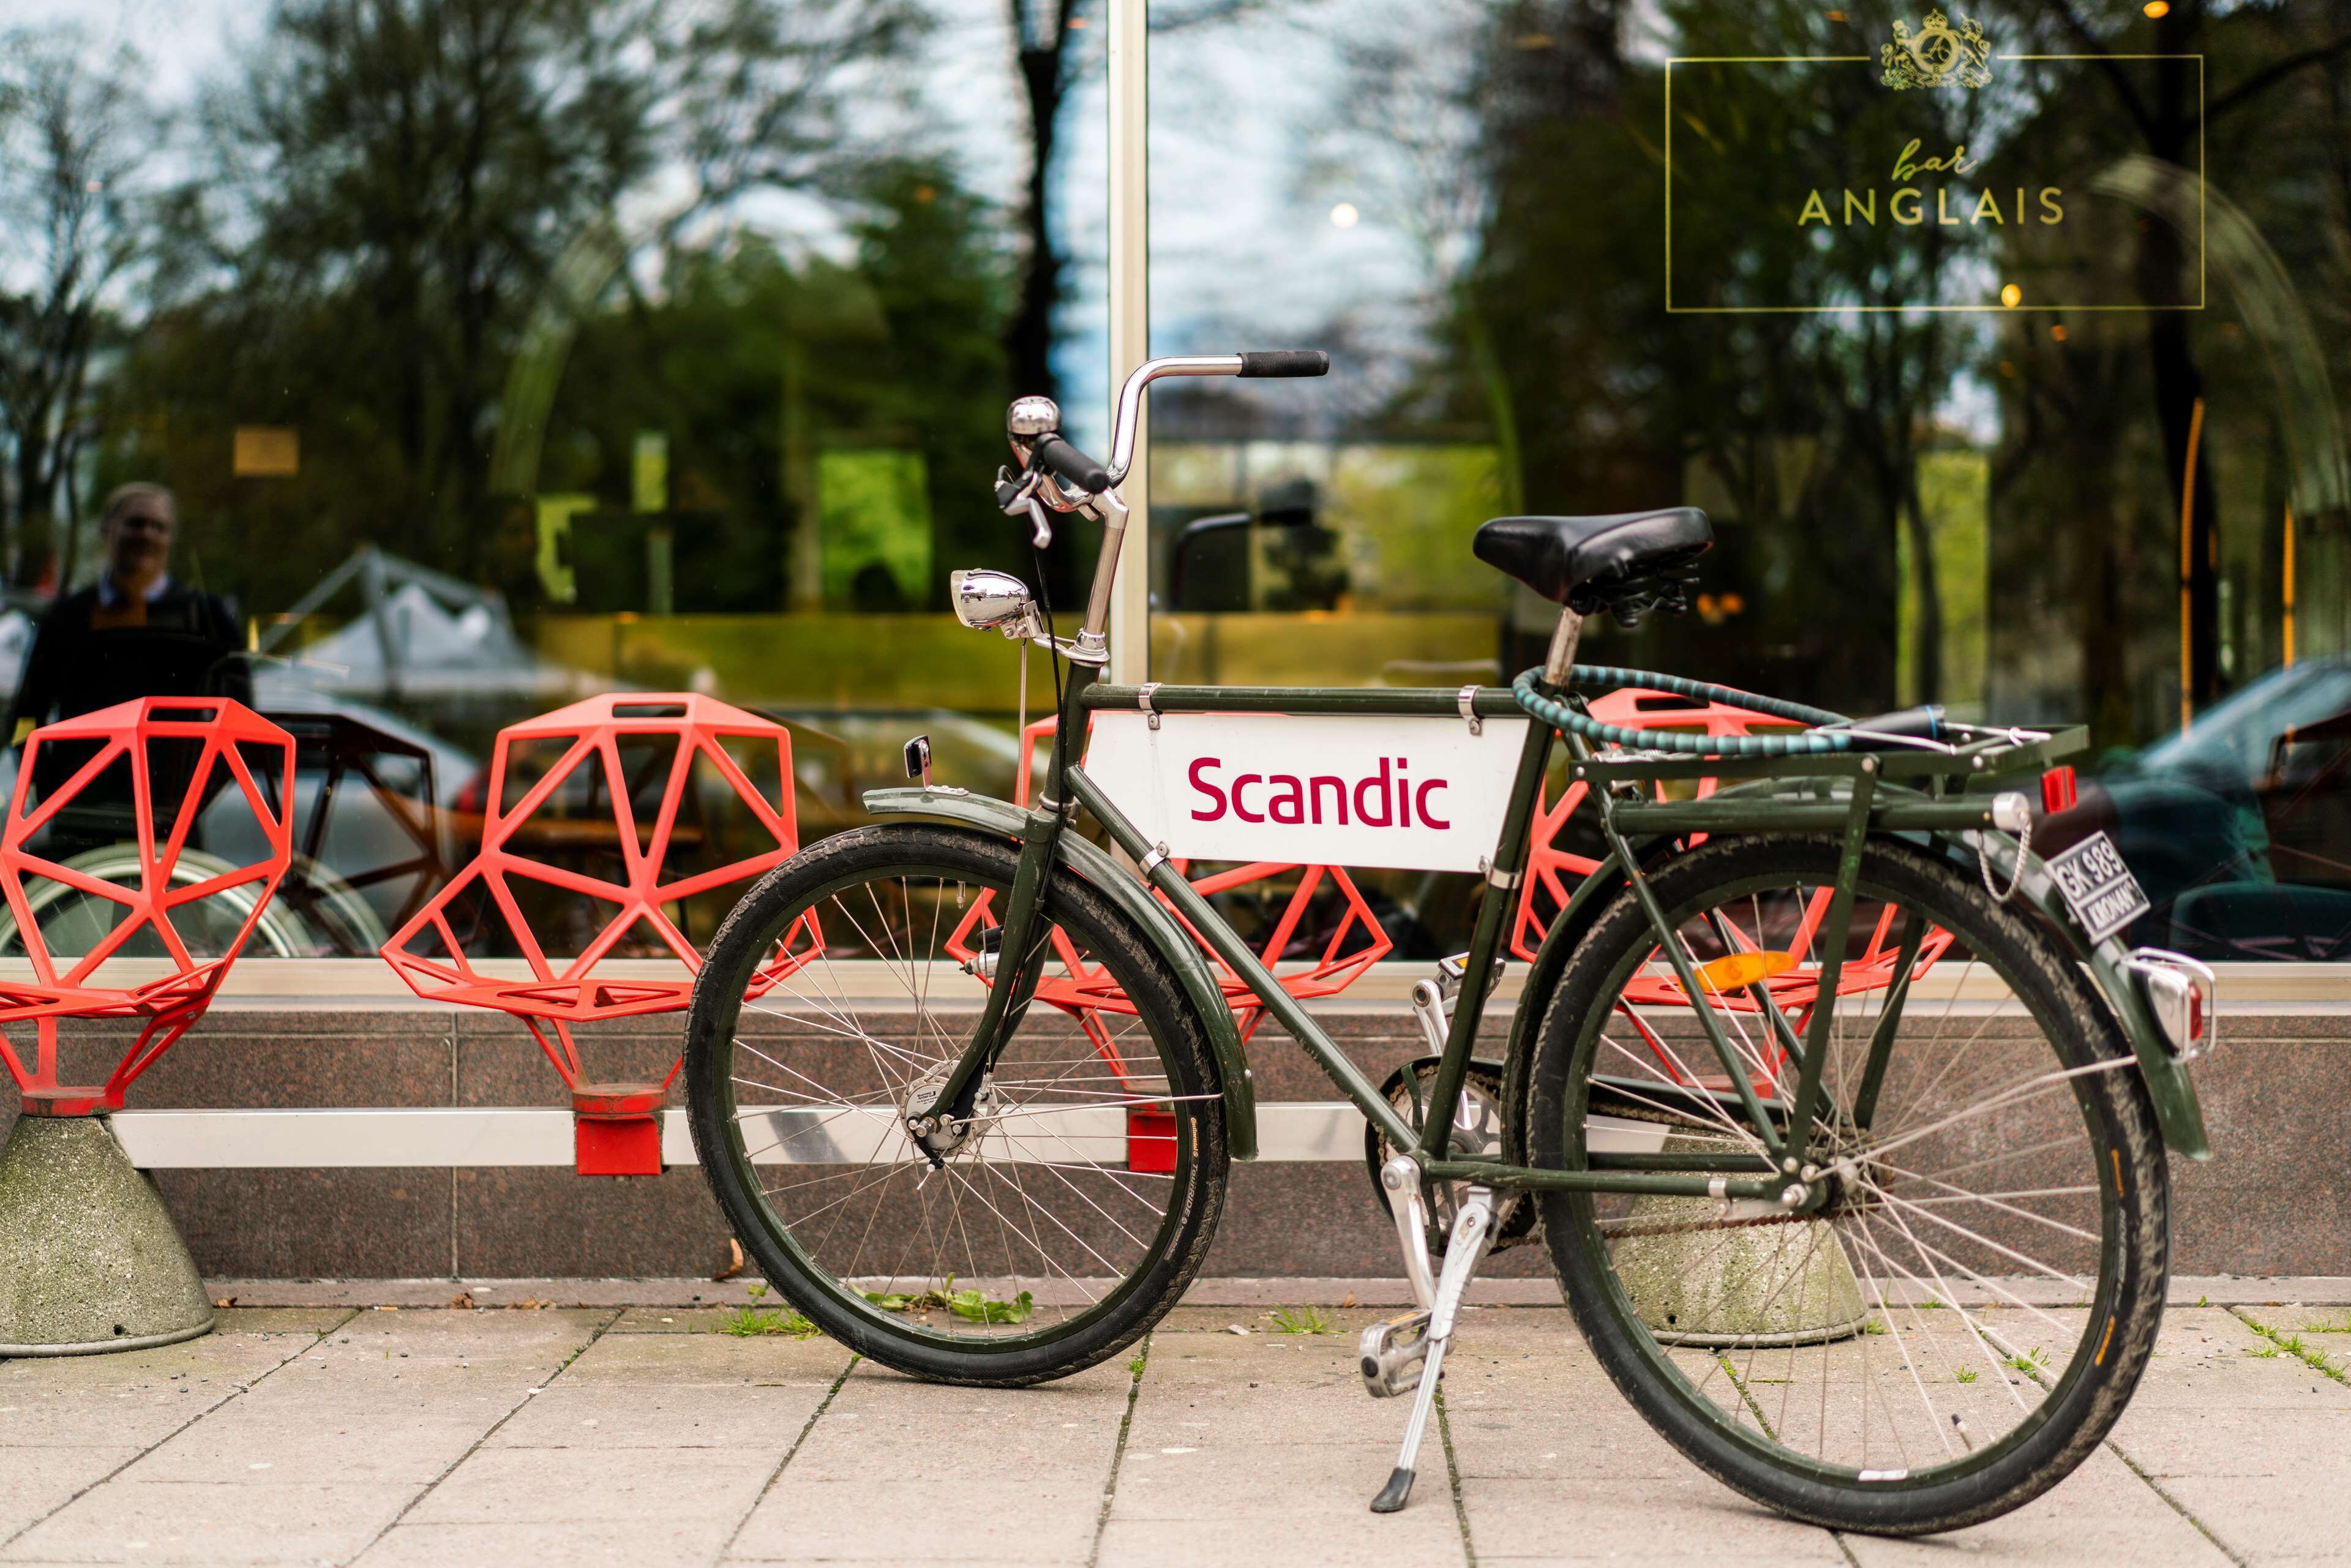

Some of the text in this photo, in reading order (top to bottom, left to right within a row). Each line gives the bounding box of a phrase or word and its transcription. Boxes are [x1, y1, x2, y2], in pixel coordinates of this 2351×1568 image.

[1891, 138, 1978, 181] bar
[1798, 187, 2064, 225] ANGLAIS
[1188, 757, 1450, 830] Scandic
[2057, 841, 2123, 898] GK 989
